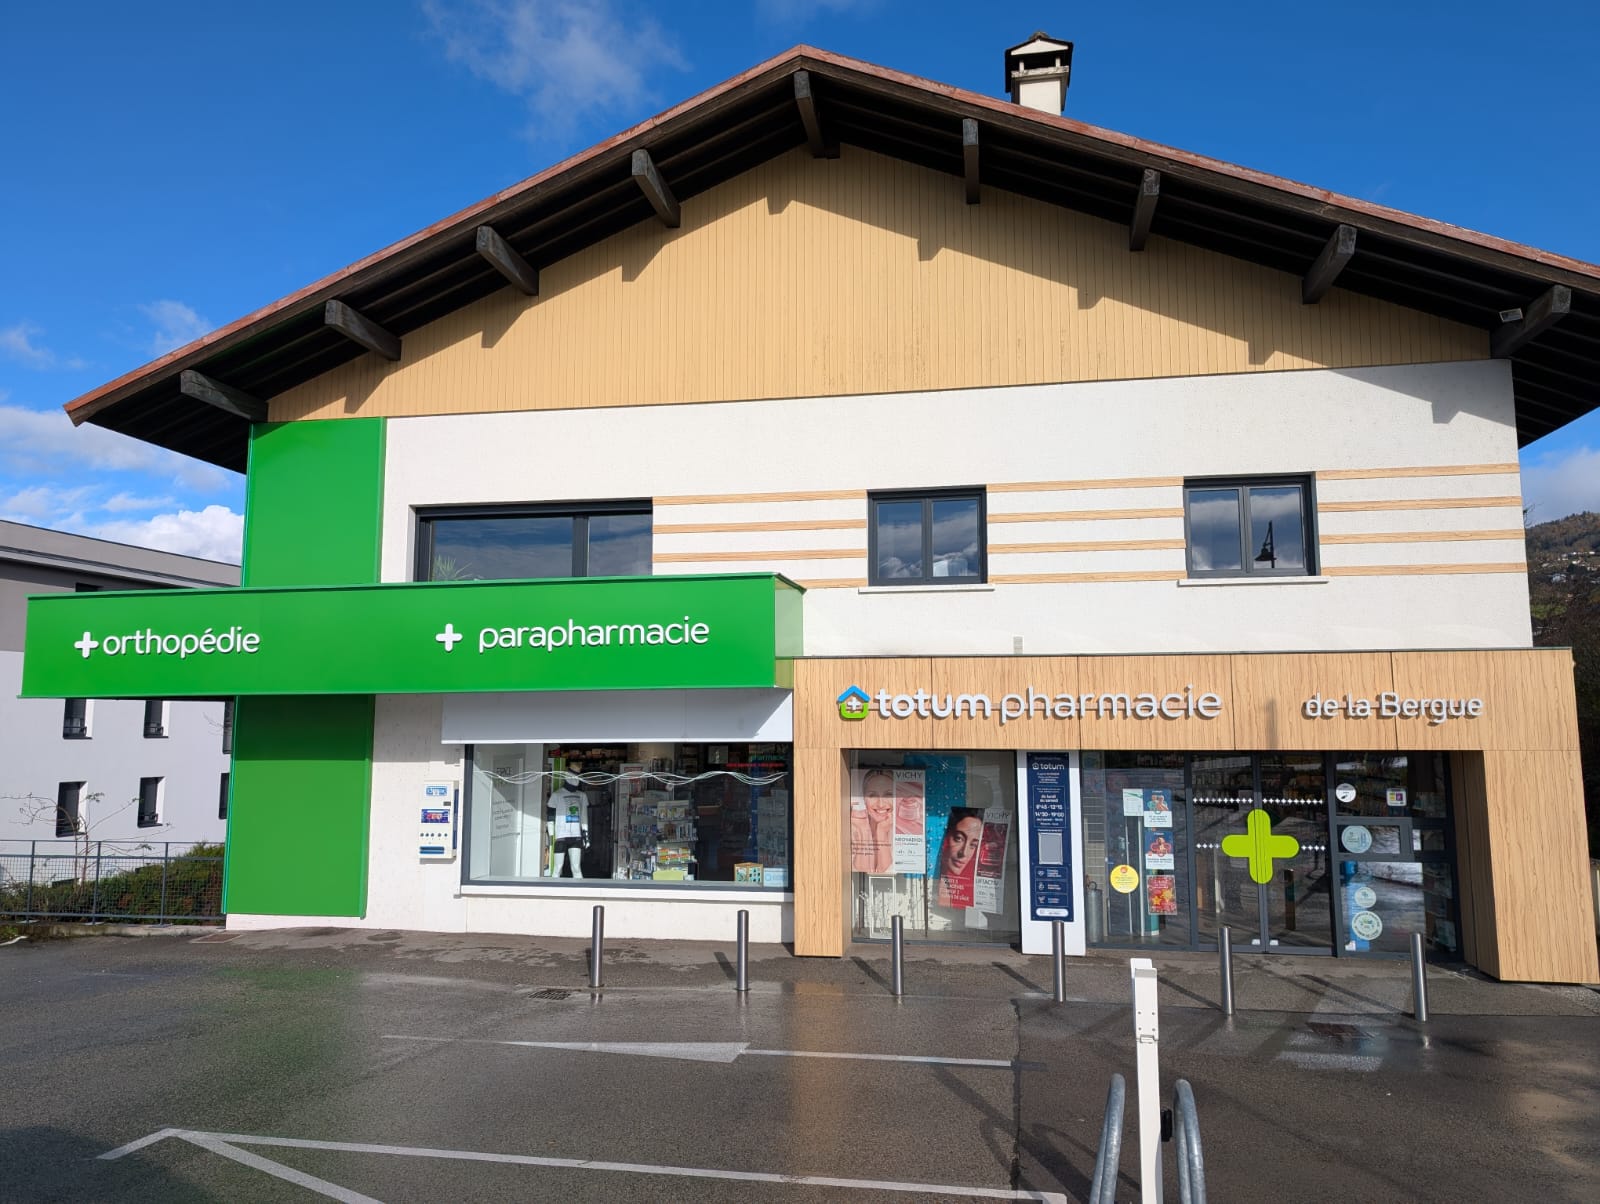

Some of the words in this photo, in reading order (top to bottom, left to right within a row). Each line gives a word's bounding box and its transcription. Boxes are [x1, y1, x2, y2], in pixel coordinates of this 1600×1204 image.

[102, 626, 260, 659] orthopédie
[478, 616, 710, 653] parapharmacie
[875, 688, 992, 718] totum
[1000, 683, 1222, 724] pharmacie
[1305, 692, 1338, 717] de
[1347, 692, 1371, 717] la
[1380, 691, 1484, 723] Bergue
[986, 811, 1009, 819] VICHY
